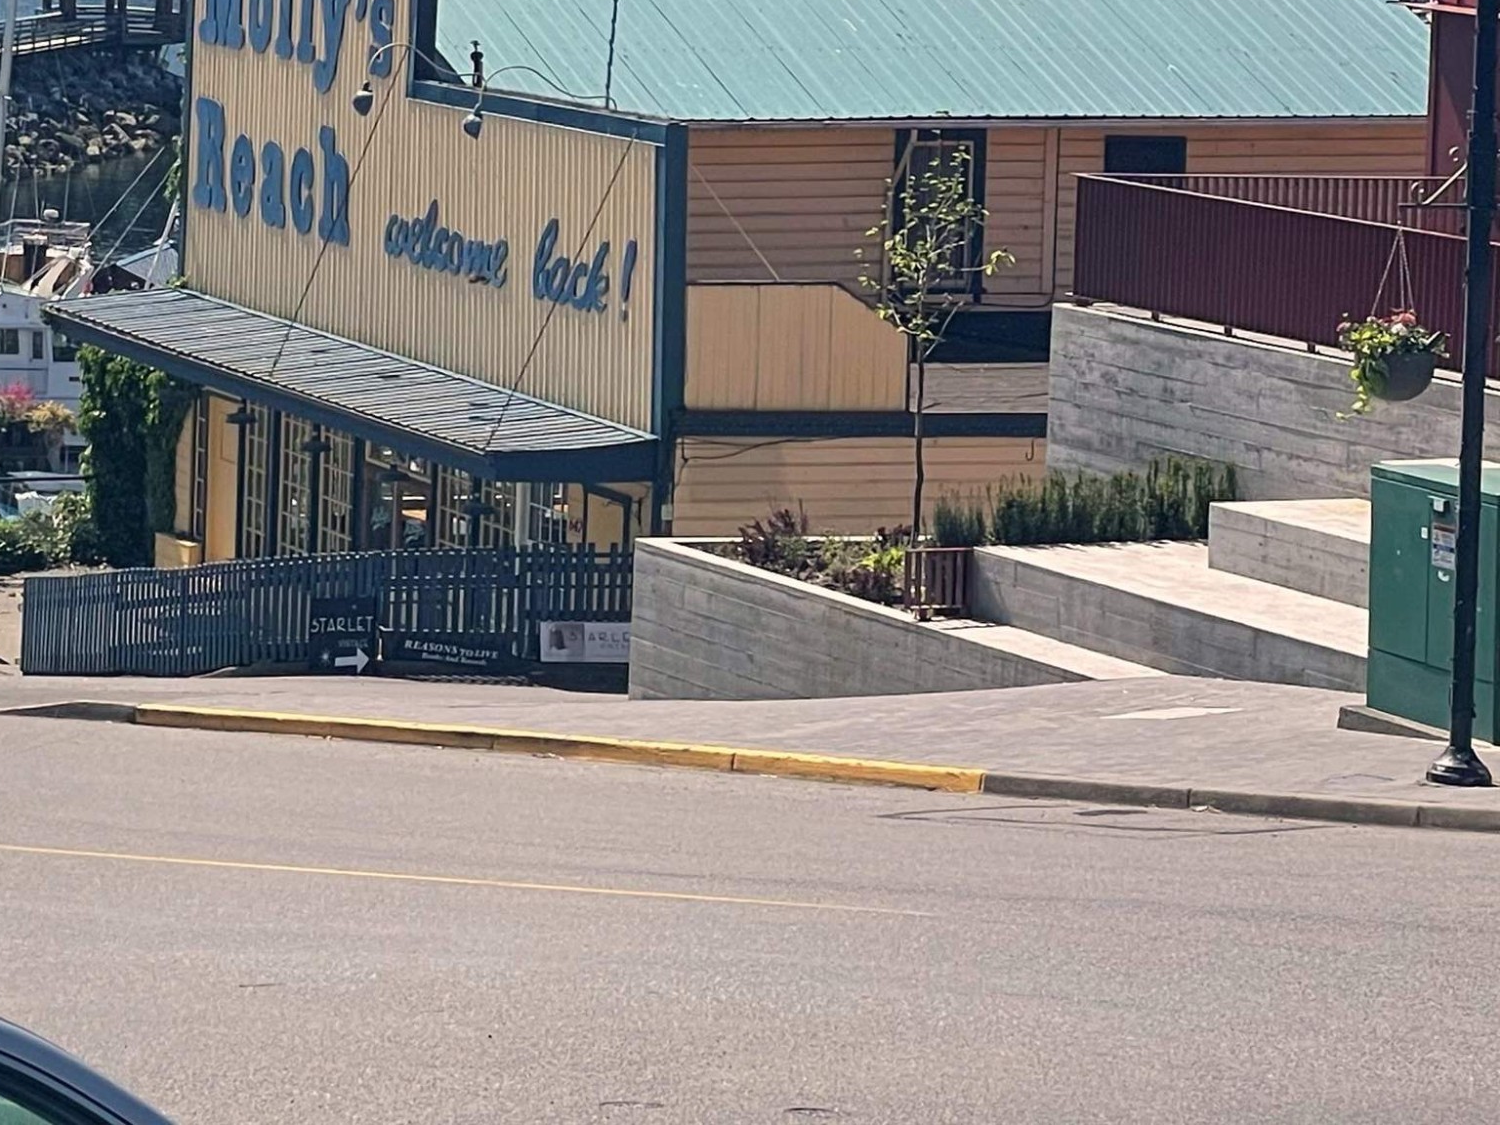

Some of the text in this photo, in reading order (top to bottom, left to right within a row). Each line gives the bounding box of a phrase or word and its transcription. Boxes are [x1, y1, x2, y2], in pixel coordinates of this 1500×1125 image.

[193, 96, 352, 248] Reach
[384, 199, 510, 288] welcome
[310, 615, 374, 634] STARLET
[404, 639, 498, 659] REASONS TO LIVE
